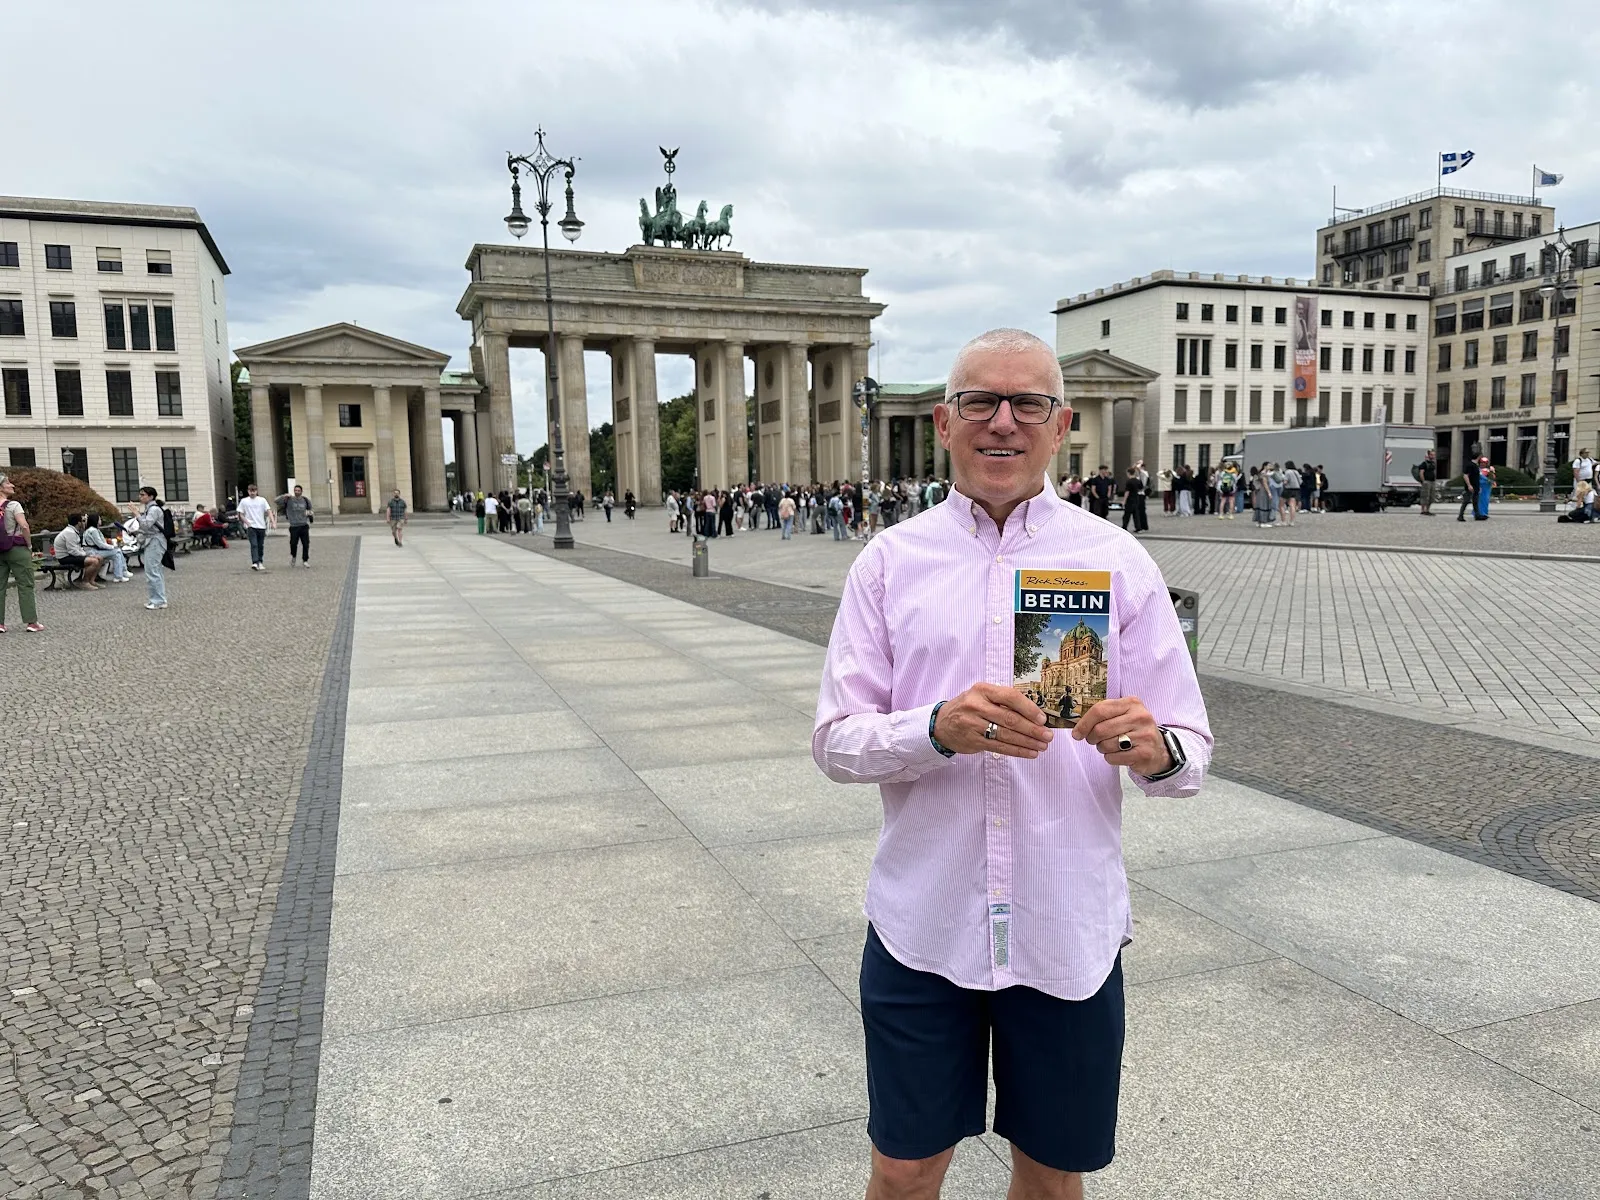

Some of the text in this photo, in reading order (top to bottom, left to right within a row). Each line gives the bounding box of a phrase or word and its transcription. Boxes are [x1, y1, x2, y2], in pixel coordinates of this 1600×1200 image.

[1026, 576, 1085, 586] Rick Steves
[1024, 593, 1104, 609] BERLIN
